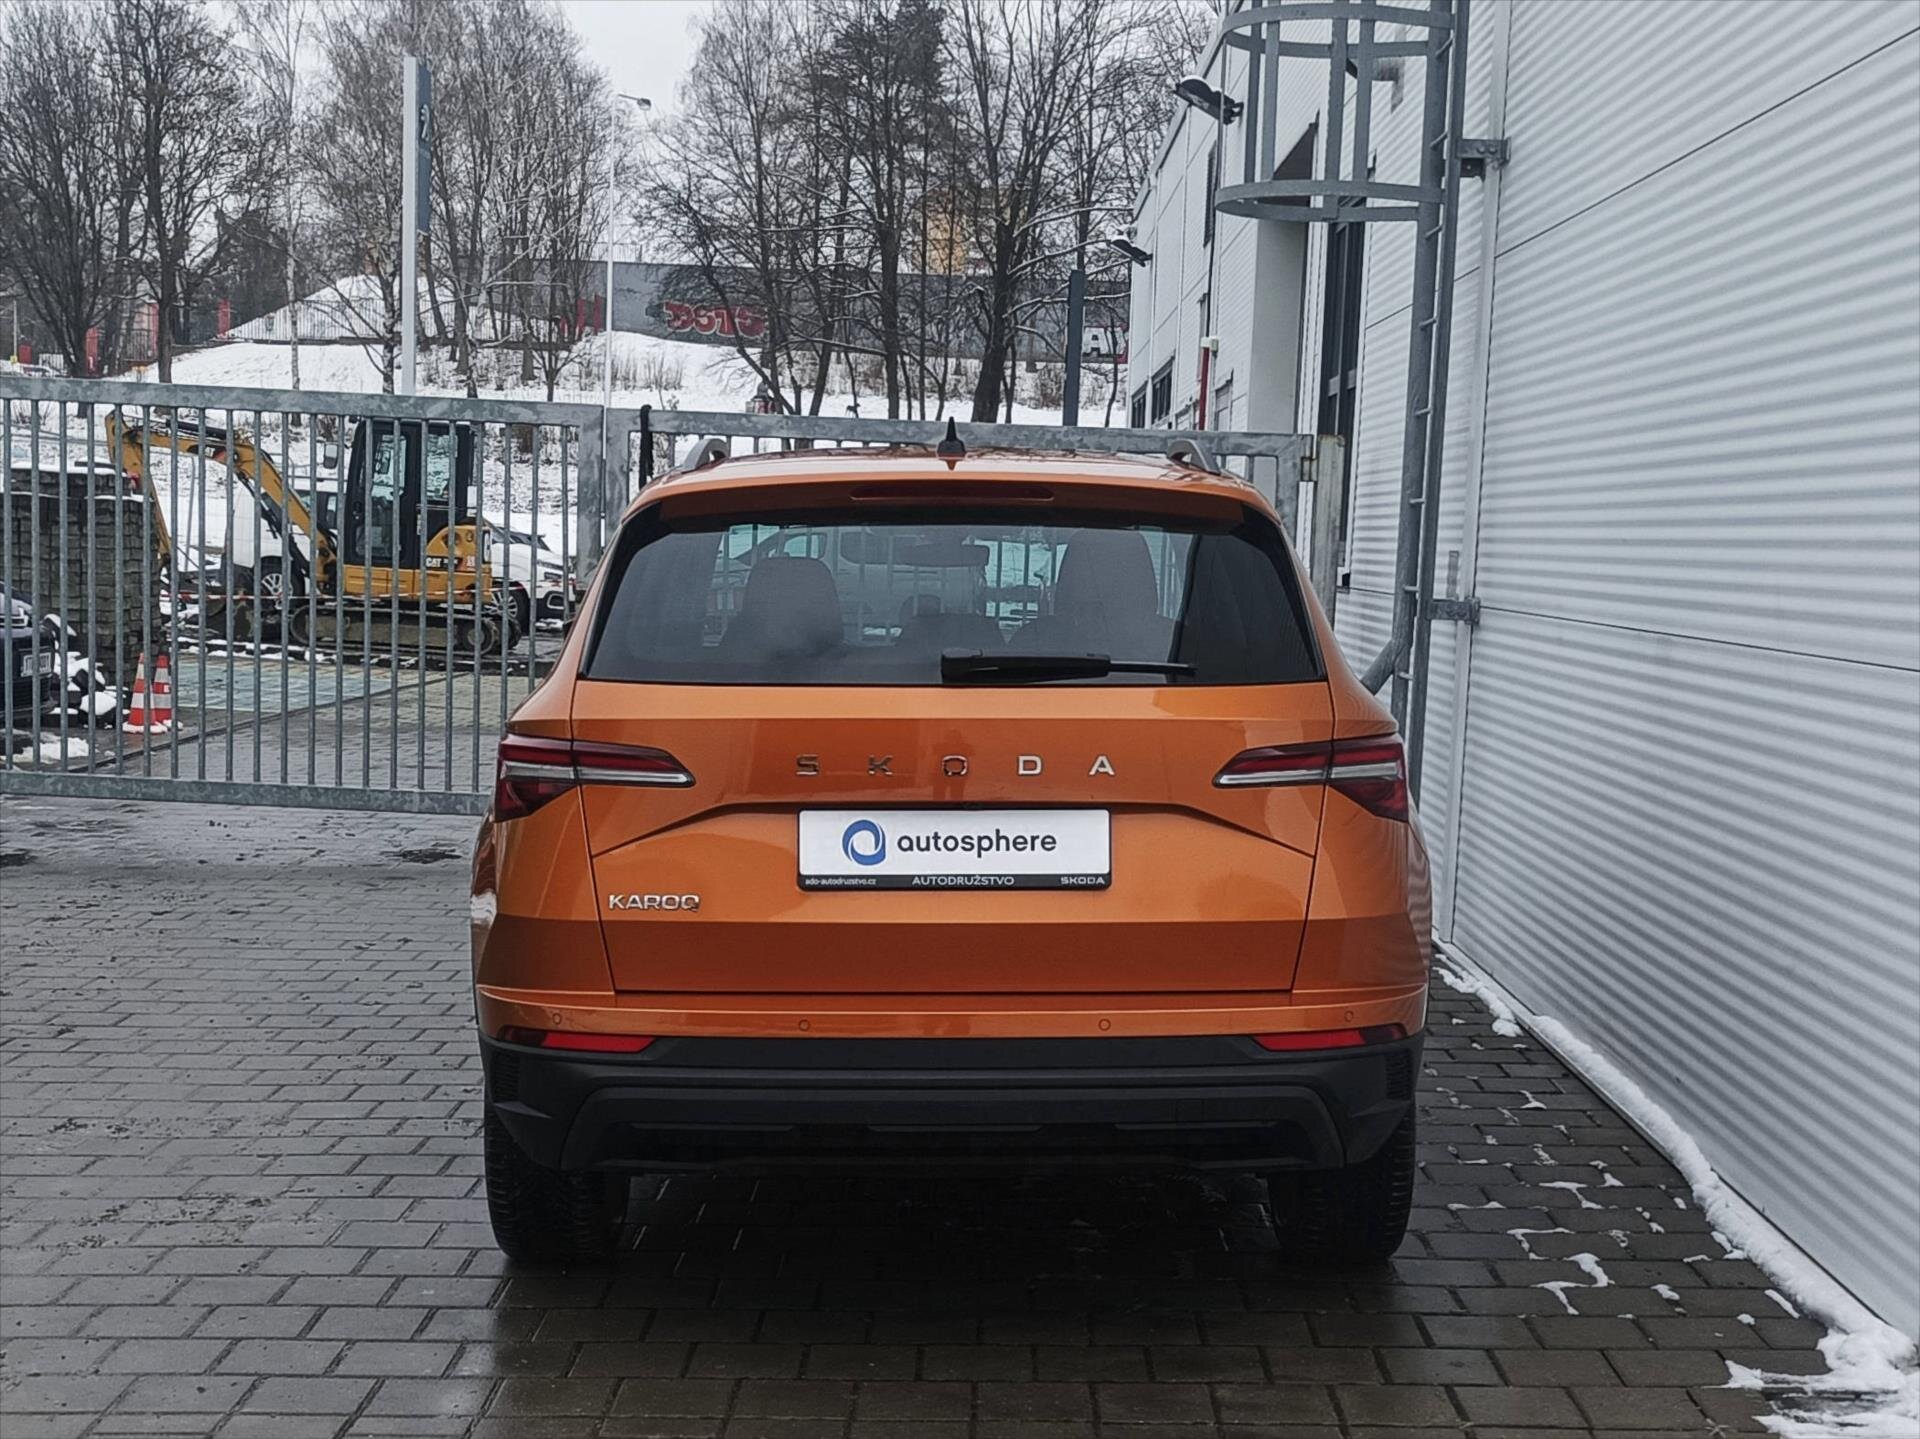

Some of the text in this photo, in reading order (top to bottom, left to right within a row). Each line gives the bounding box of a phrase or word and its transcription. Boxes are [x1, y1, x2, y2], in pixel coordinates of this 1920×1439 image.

[425, 558, 442, 568] CAT
[896, 828, 1057, 859] autosphere
[911, 874, 1015, 886] AUTODRUŽSTVO
[608, 893, 700, 913] KAROQ
